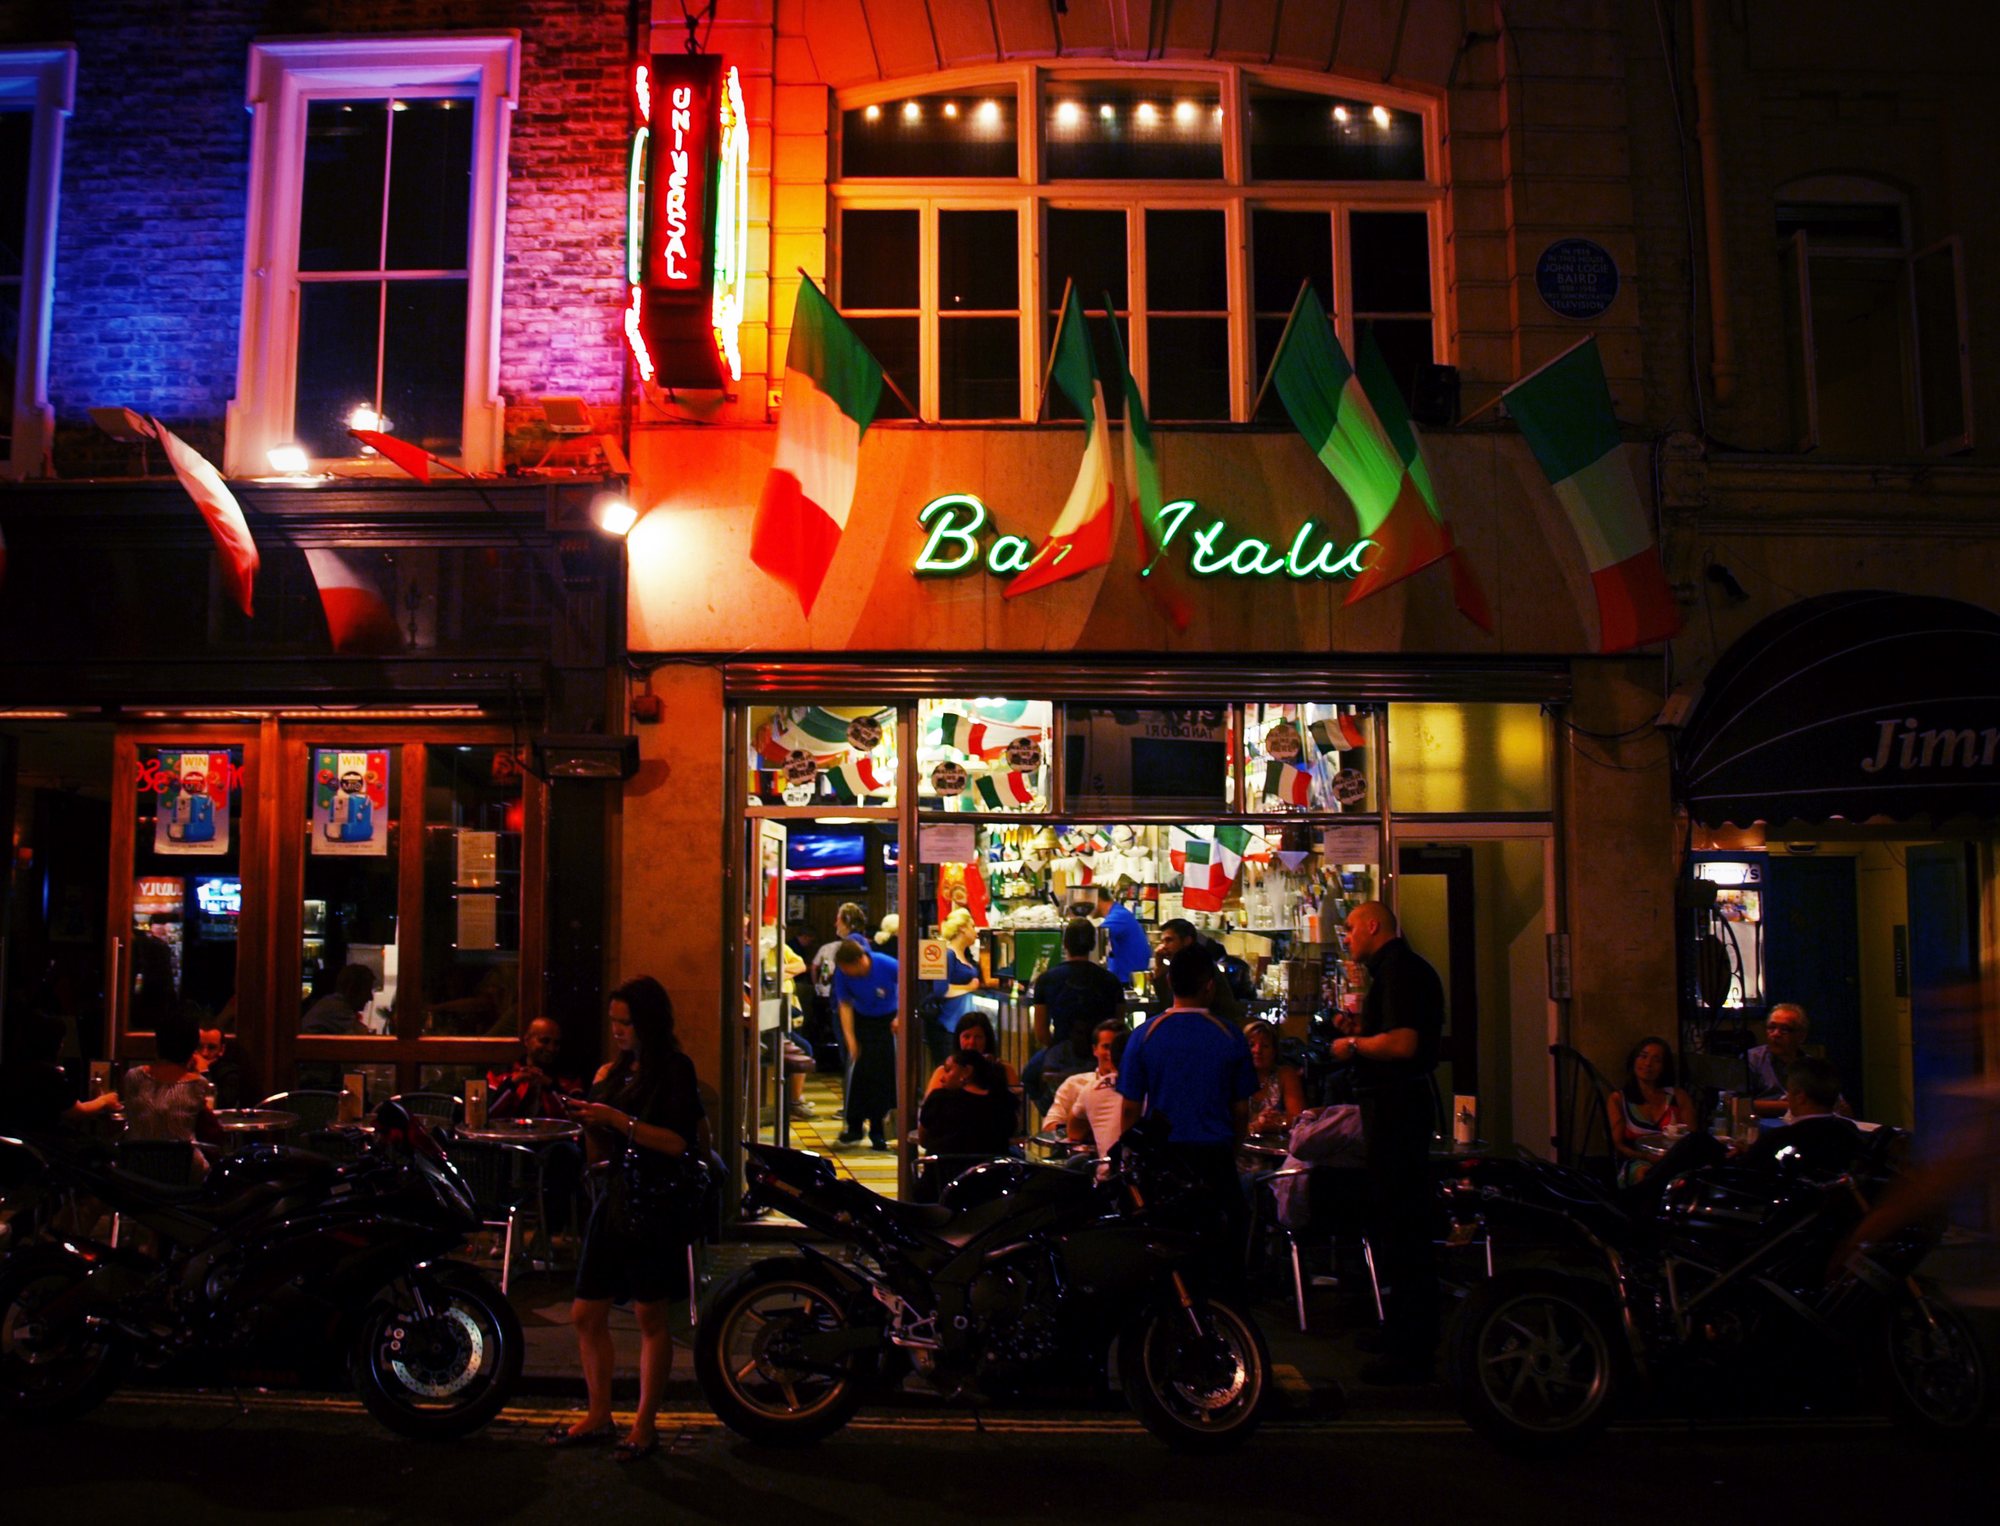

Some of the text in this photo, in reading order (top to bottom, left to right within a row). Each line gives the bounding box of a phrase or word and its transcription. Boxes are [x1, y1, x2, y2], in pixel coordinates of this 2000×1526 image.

[663, 86, 692, 280] UNIVERSAL
[1556, 273, 1598, 285] BAIRD
[183, 755, 208, 767] WIN
[341, 755, 366, 766] WIN
